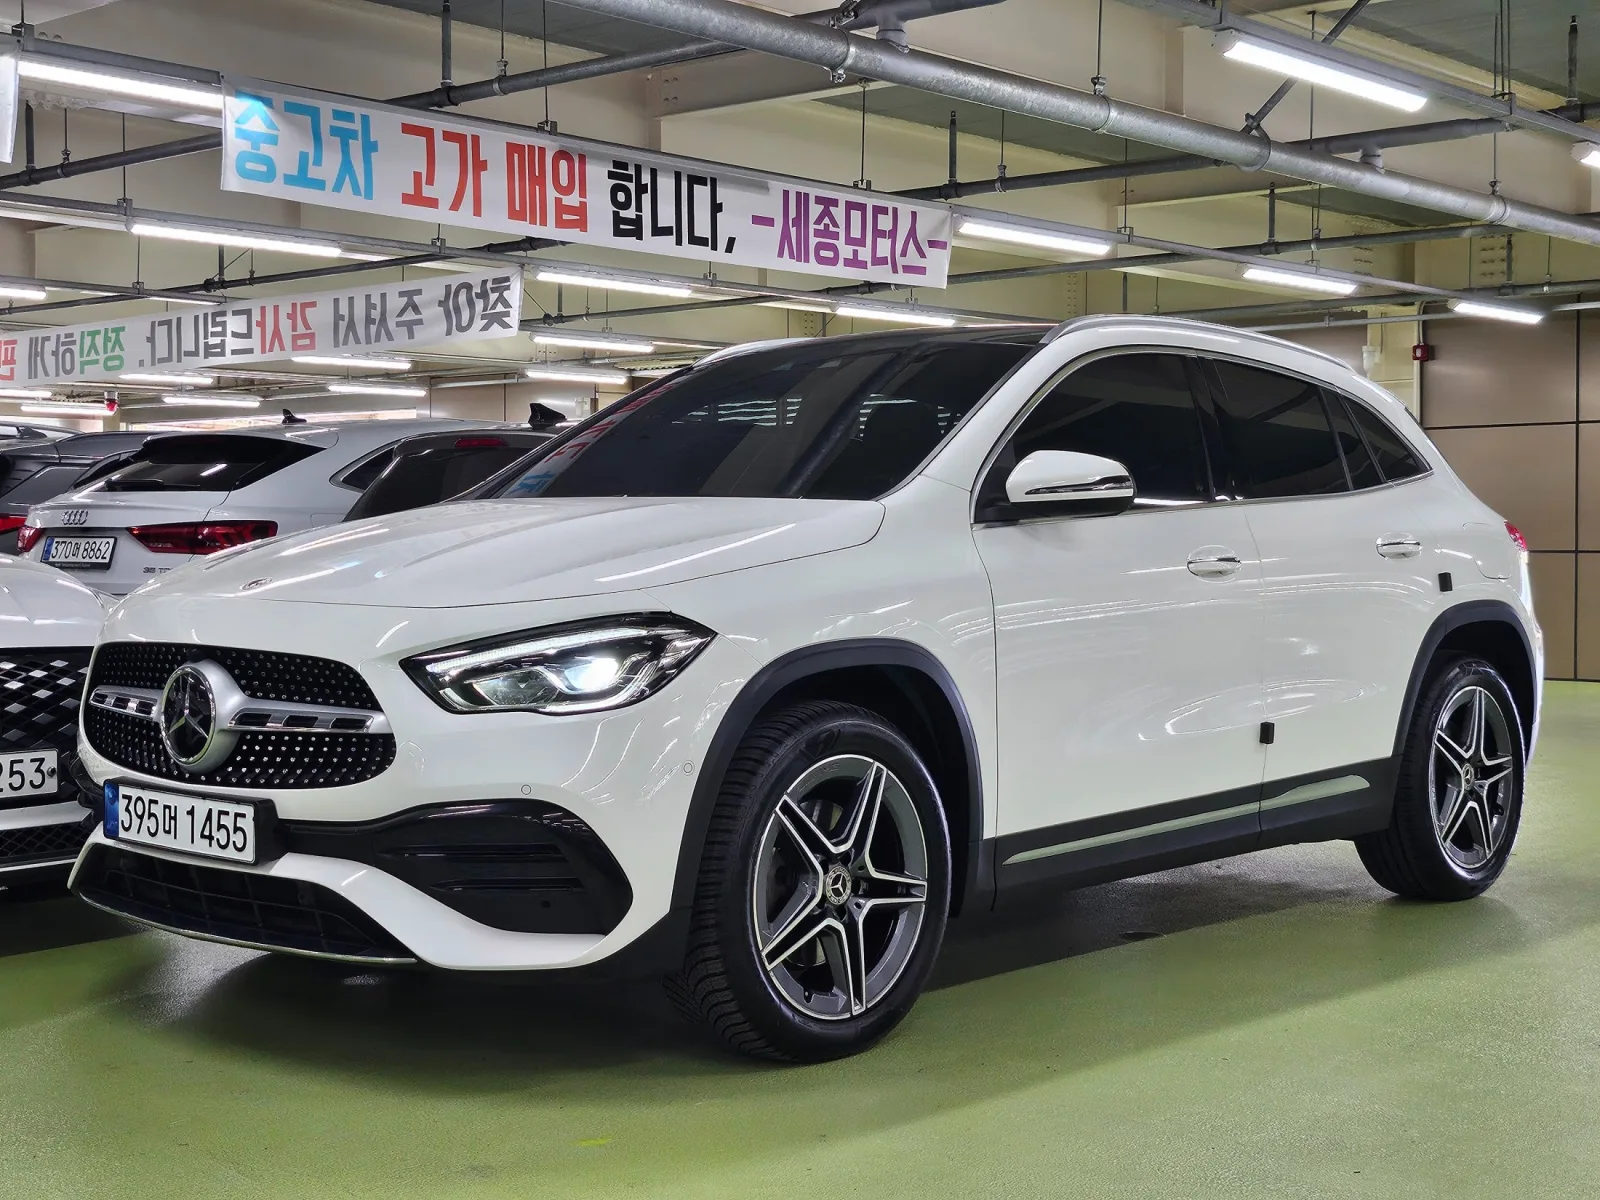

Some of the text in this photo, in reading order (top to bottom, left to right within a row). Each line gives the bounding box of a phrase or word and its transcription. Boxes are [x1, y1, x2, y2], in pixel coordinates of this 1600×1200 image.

[234, 89, 947, 276] 중고차 고가 매입 합니다, -세종모터스-
[82, 541, 110, 560] 8862
[0, 757, 46, 793] 53
[120, 793, 248, 853] 395머 1455
